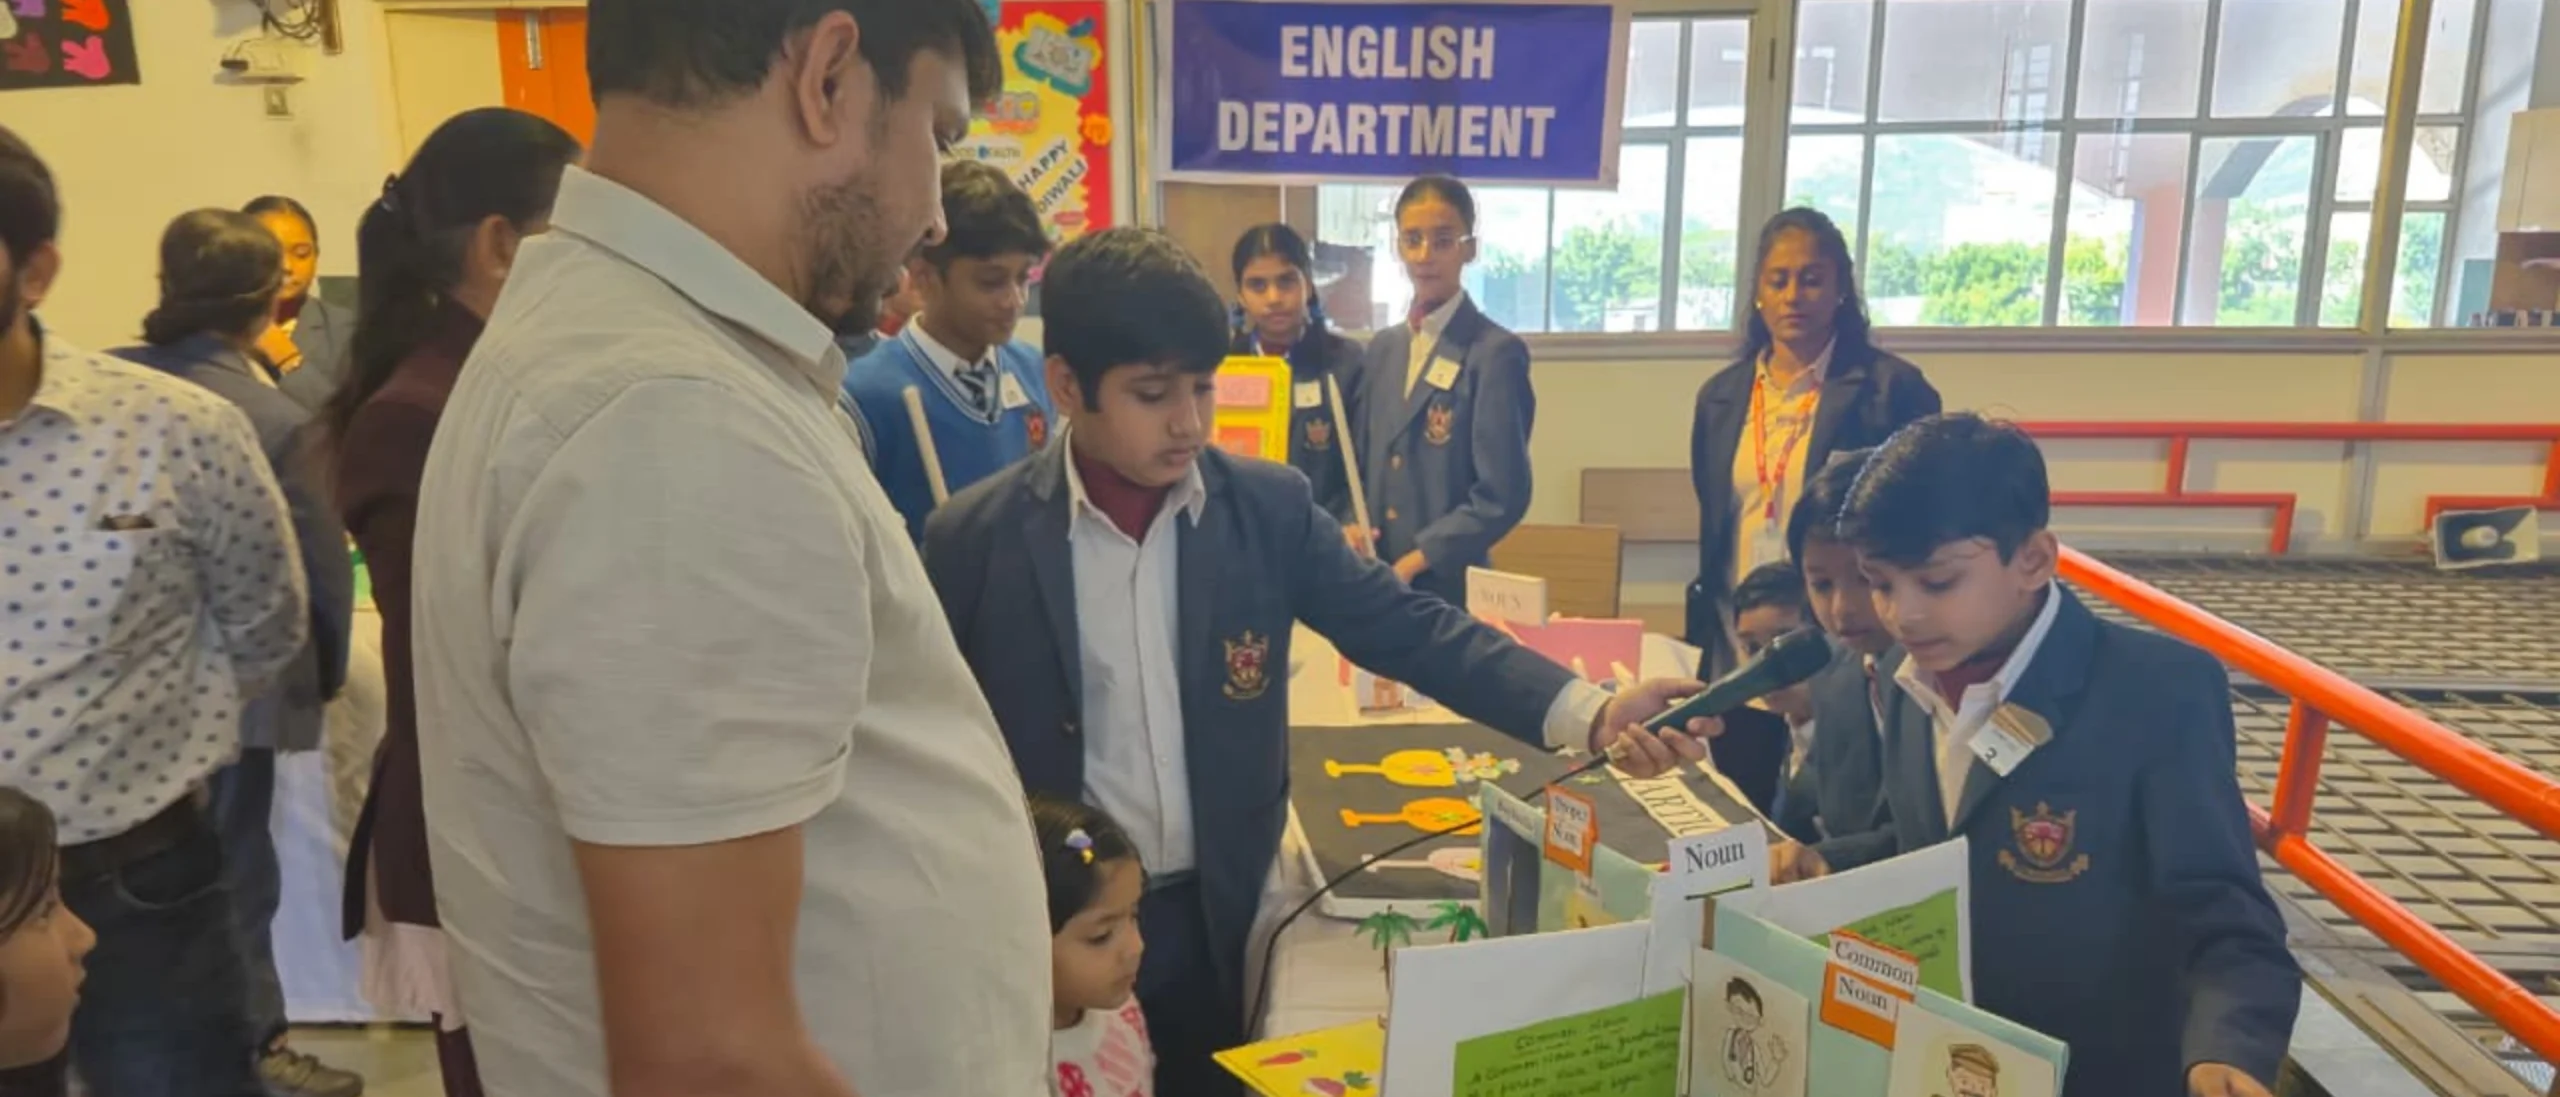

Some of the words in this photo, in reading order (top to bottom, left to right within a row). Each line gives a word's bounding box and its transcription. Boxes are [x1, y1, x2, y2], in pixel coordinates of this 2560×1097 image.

[1281, 25, 1495, 79] ENGLISH
[1218, 101, 1556, 158] DEPARTMENT
[1018, 138, 1068, 190] HAPPY
[1684, 841, 1745, 874] Noun
[1835, 940, 1914, 986] Common
[1839, 975, 1888, 1012] Noun
